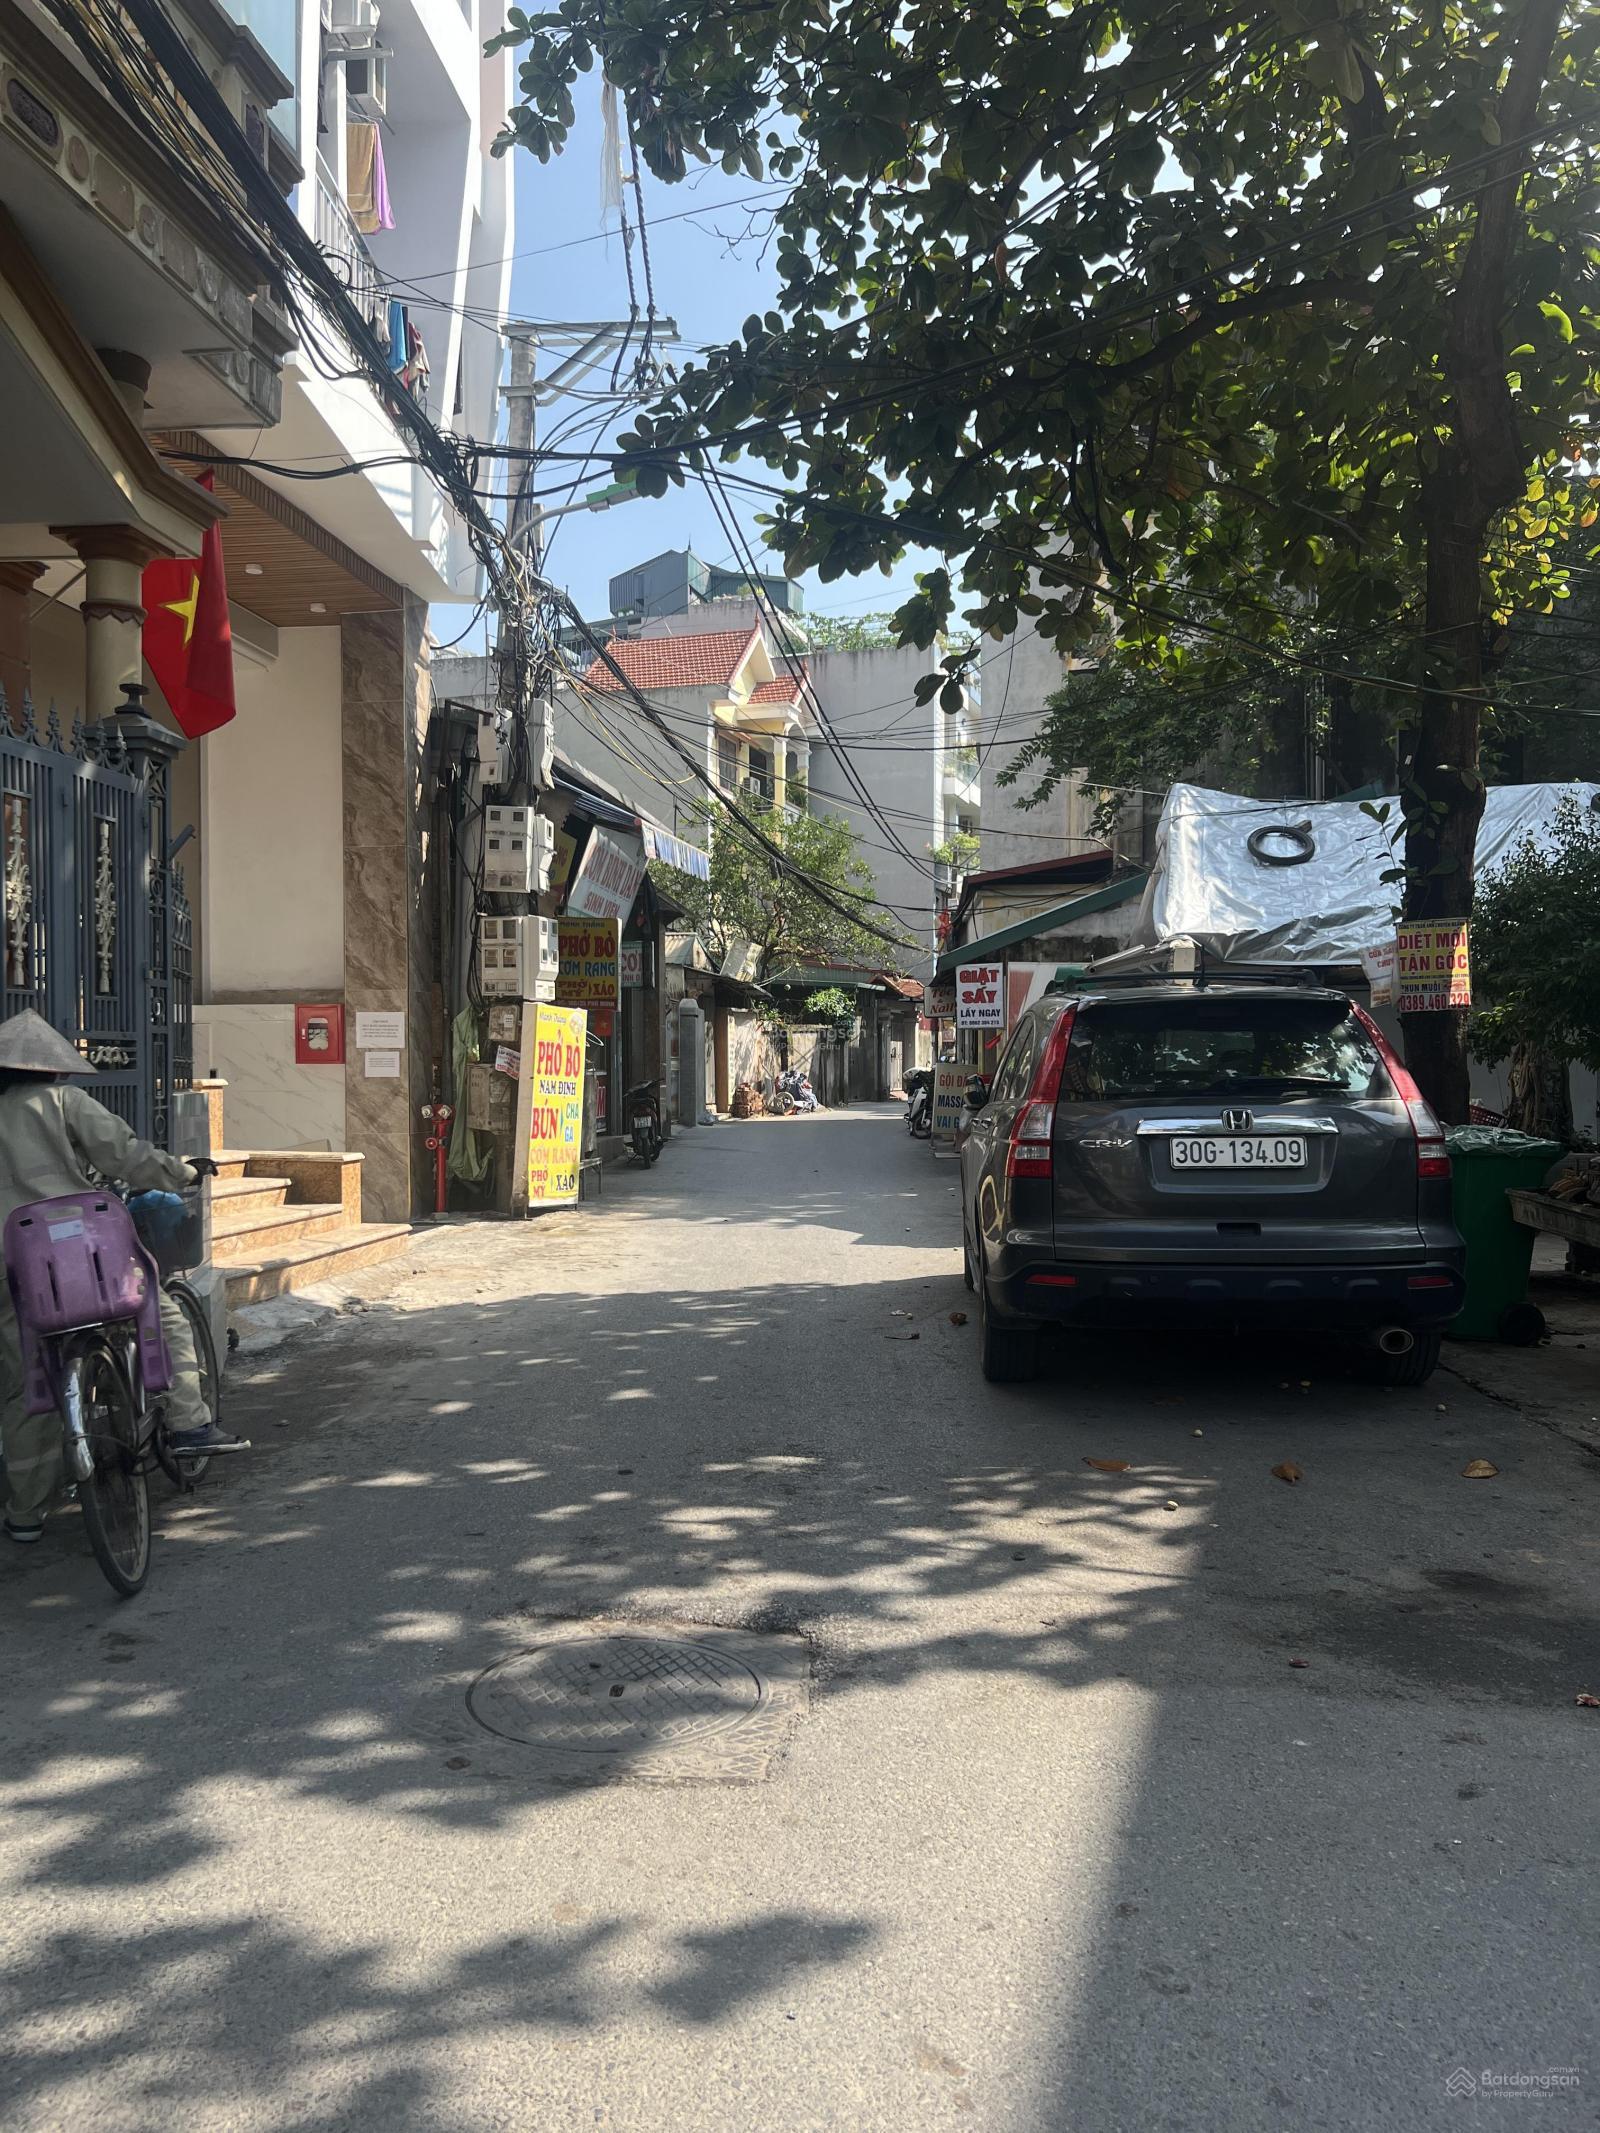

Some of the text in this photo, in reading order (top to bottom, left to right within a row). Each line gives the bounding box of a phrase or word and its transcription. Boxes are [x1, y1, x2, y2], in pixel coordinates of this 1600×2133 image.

[558, 929, 616, 958] PHỞ BÒ
[1398, 928, 1466, 952] DIỆT MỐI
[584, 961, 616, 977] RANG
[1399, 950, 1467, 975] TẬN GỐC
[959, 966, 1000, 985] GIẶT
[961, 986, 998, 1004] SẤY
[960, 1006, 1001, 1018] LẤY NGAY
[537, 1029, 564, 1077] PHỞ
[565, 1036, 581, 1078] BÒ
[539, 1080, 577, 1098] NAM ĐỊNH
[939, 1072, 955, 1089] GỘI
[937, 1095, 966, 1108] MASSA
[531, 1098, 559, 1140] BÚN
[936, 1115, 951, 1128] VAI
[1079, 1138, 1133, 1149] CR-V
[1175, 1140, 1302, 1164] 30G-134.09
[531, 1165, 549, 1182] PHỞ
